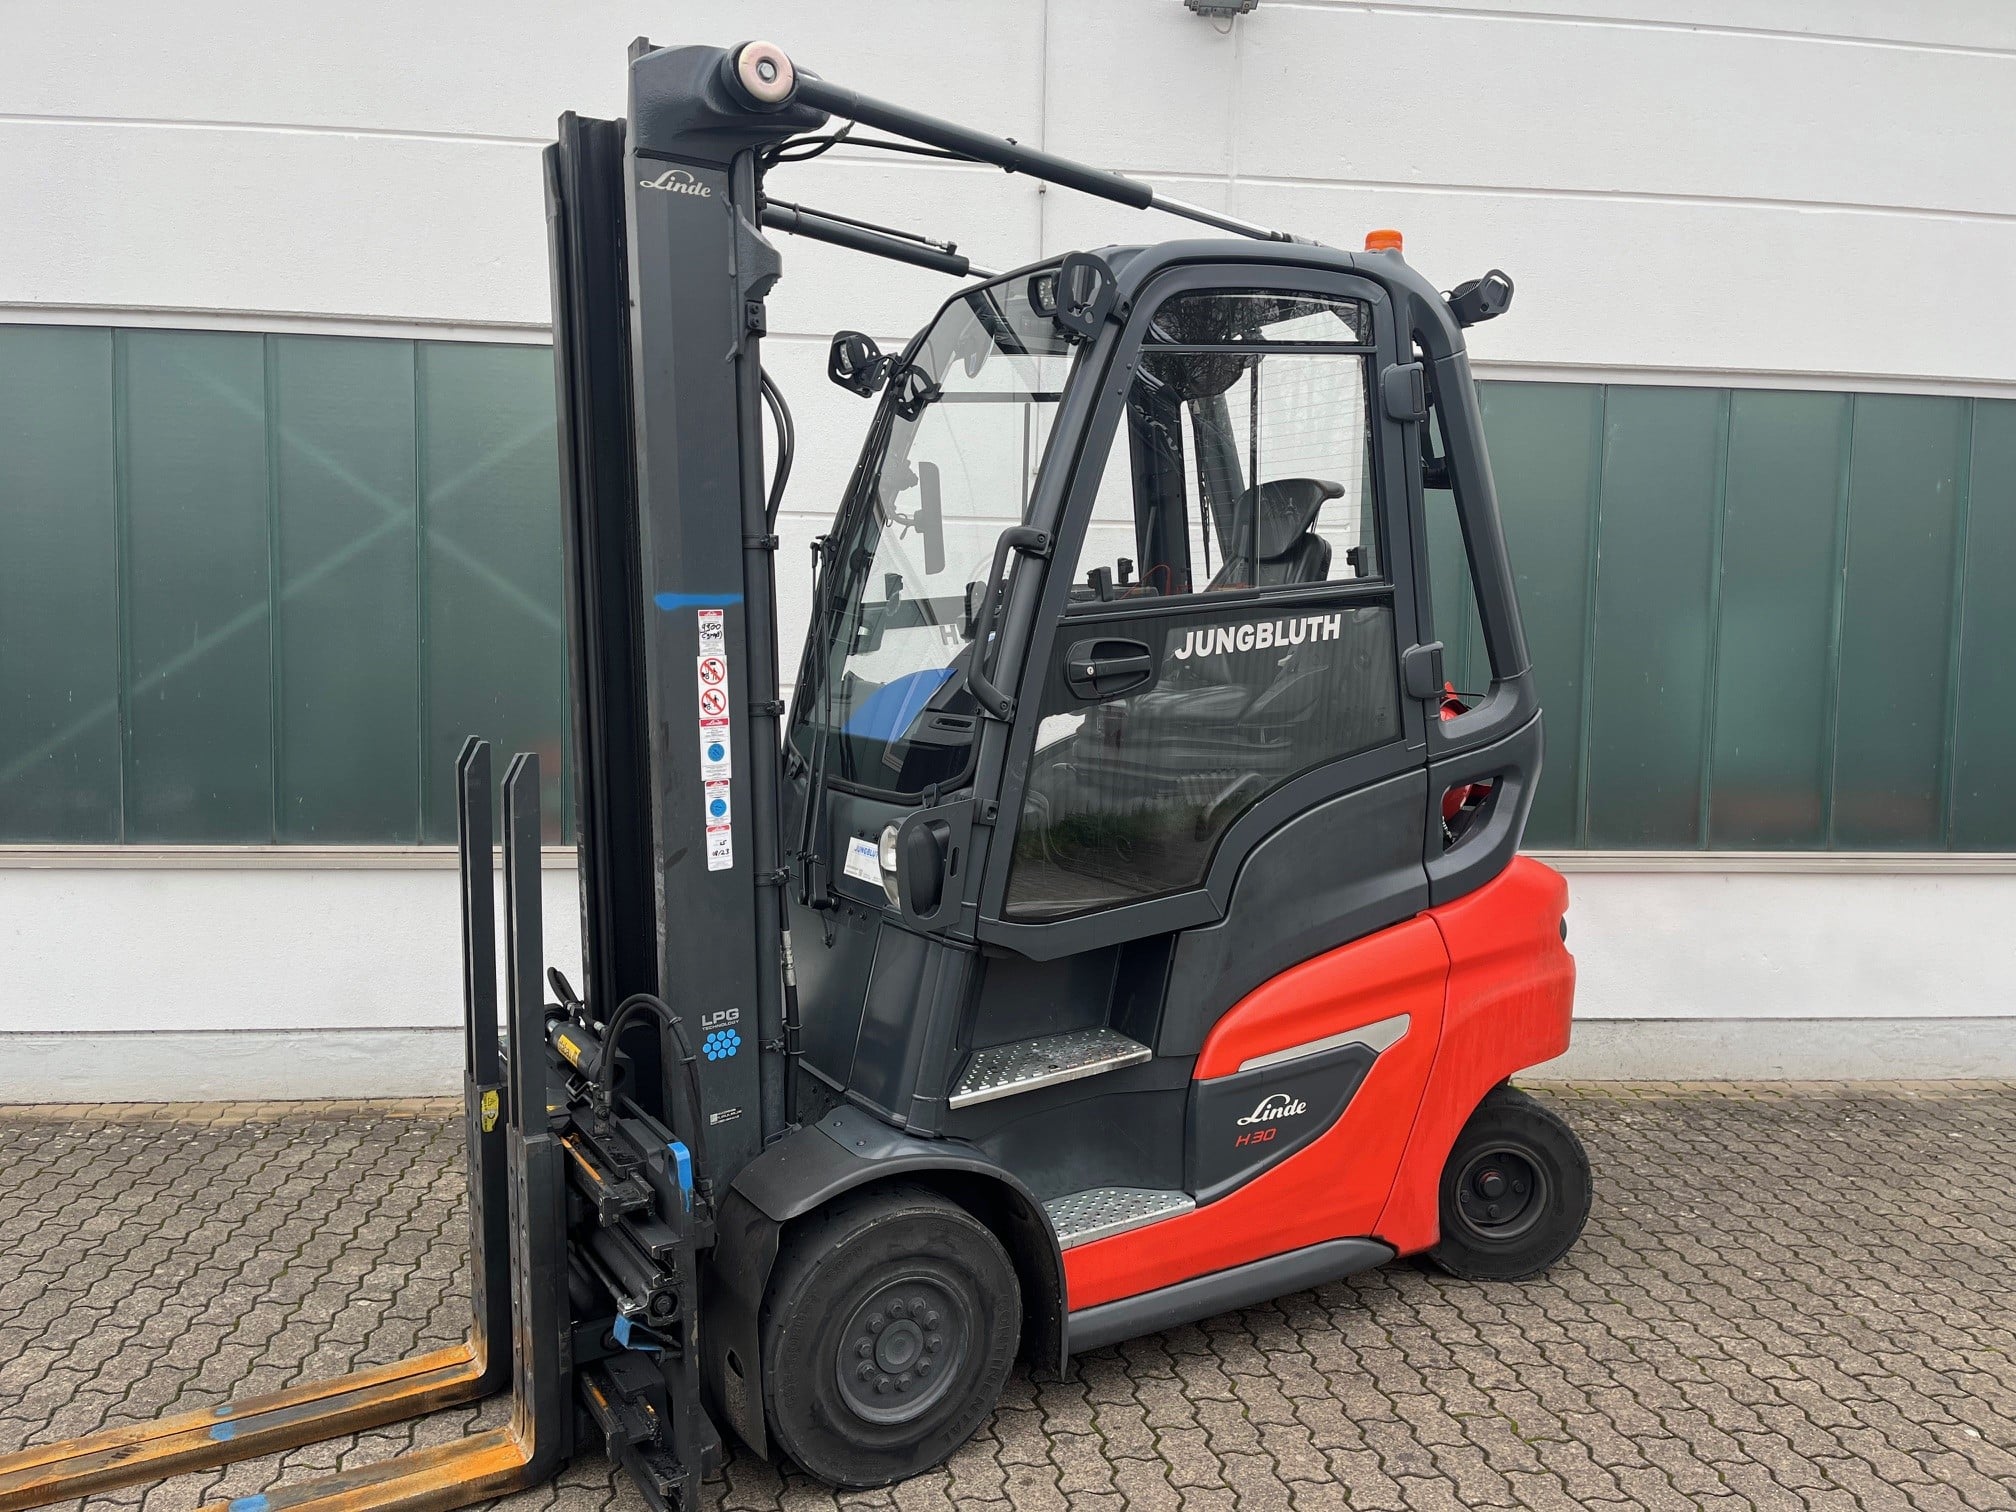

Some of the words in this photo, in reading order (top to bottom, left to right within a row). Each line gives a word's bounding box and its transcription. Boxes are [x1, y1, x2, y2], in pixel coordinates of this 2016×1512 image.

[640, 169, 712, 198] Linde
[1174, 613, 1342, 660] JUNGBLUTH
[701, 1007, 740, 1027] LPG
[1236, 1093, 1307, 1126] Linde
